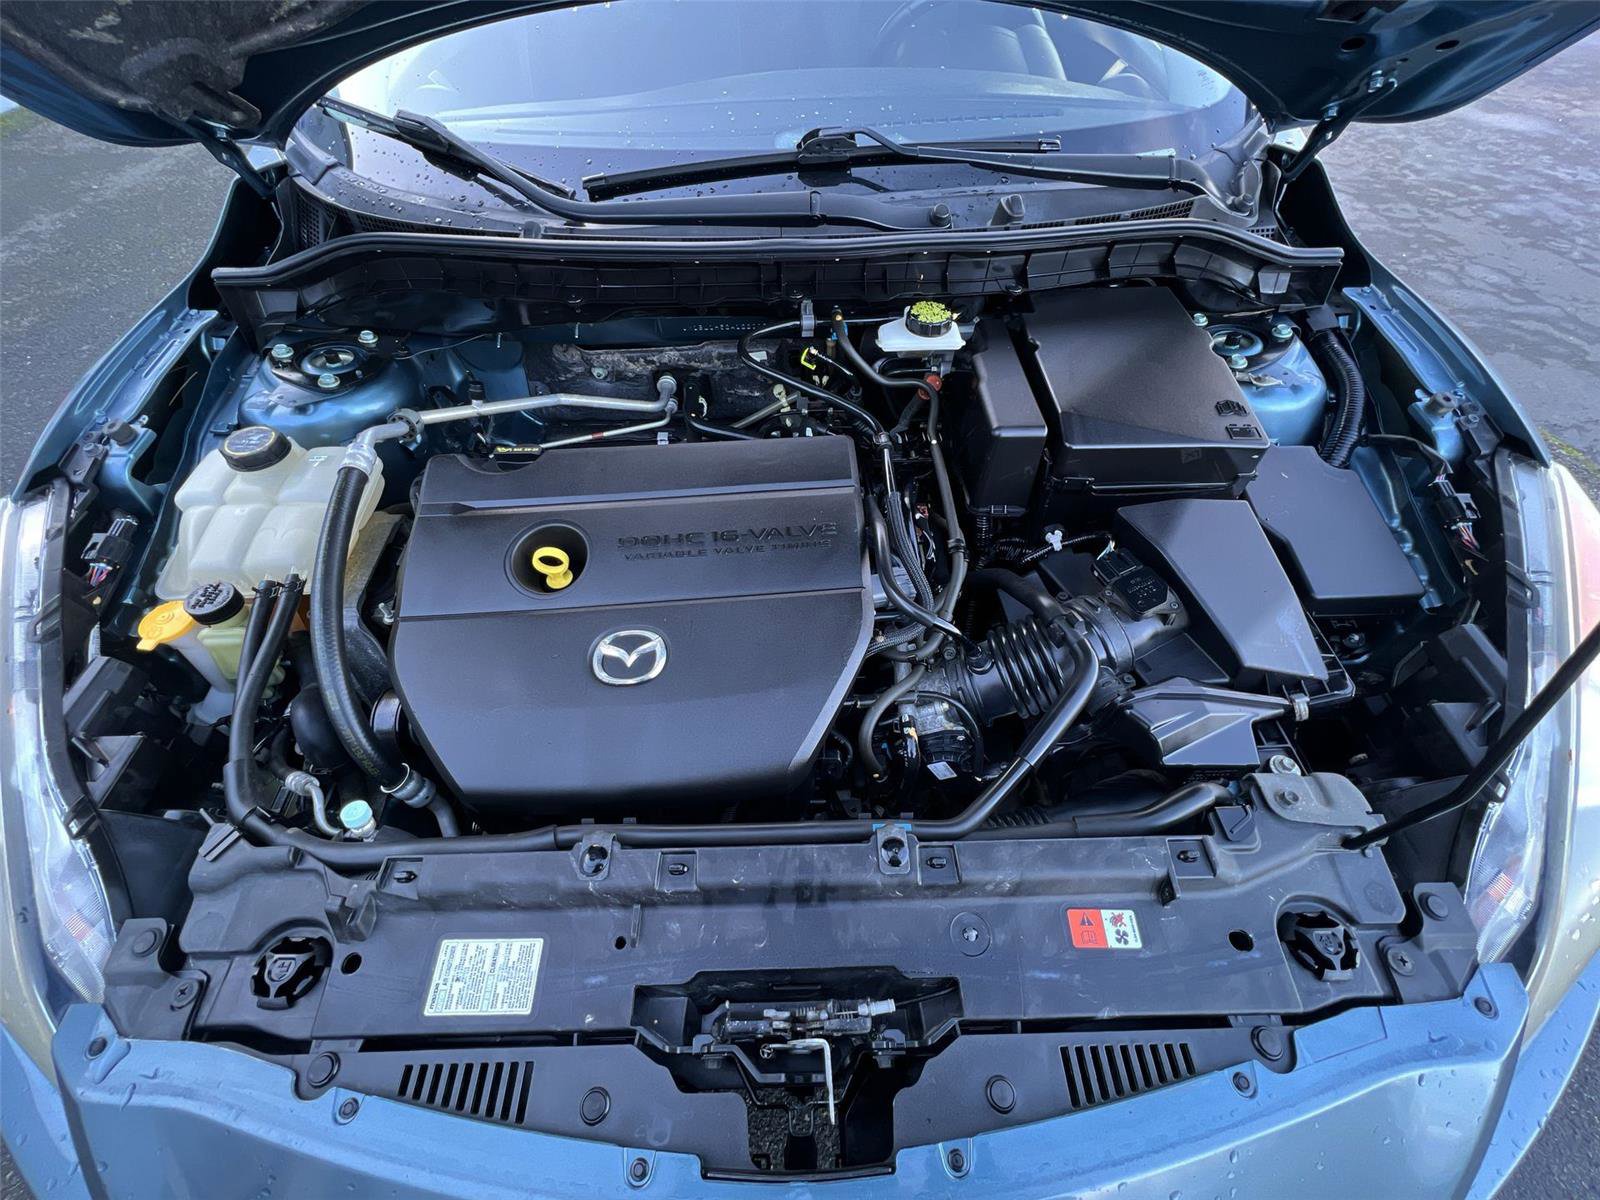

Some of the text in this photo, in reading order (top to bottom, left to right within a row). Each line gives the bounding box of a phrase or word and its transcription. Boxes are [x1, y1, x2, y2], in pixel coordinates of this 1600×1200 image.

[617, 522, 837, 548] DOHC 16-VALVE
[713, 544, 766, 556] VALVE
